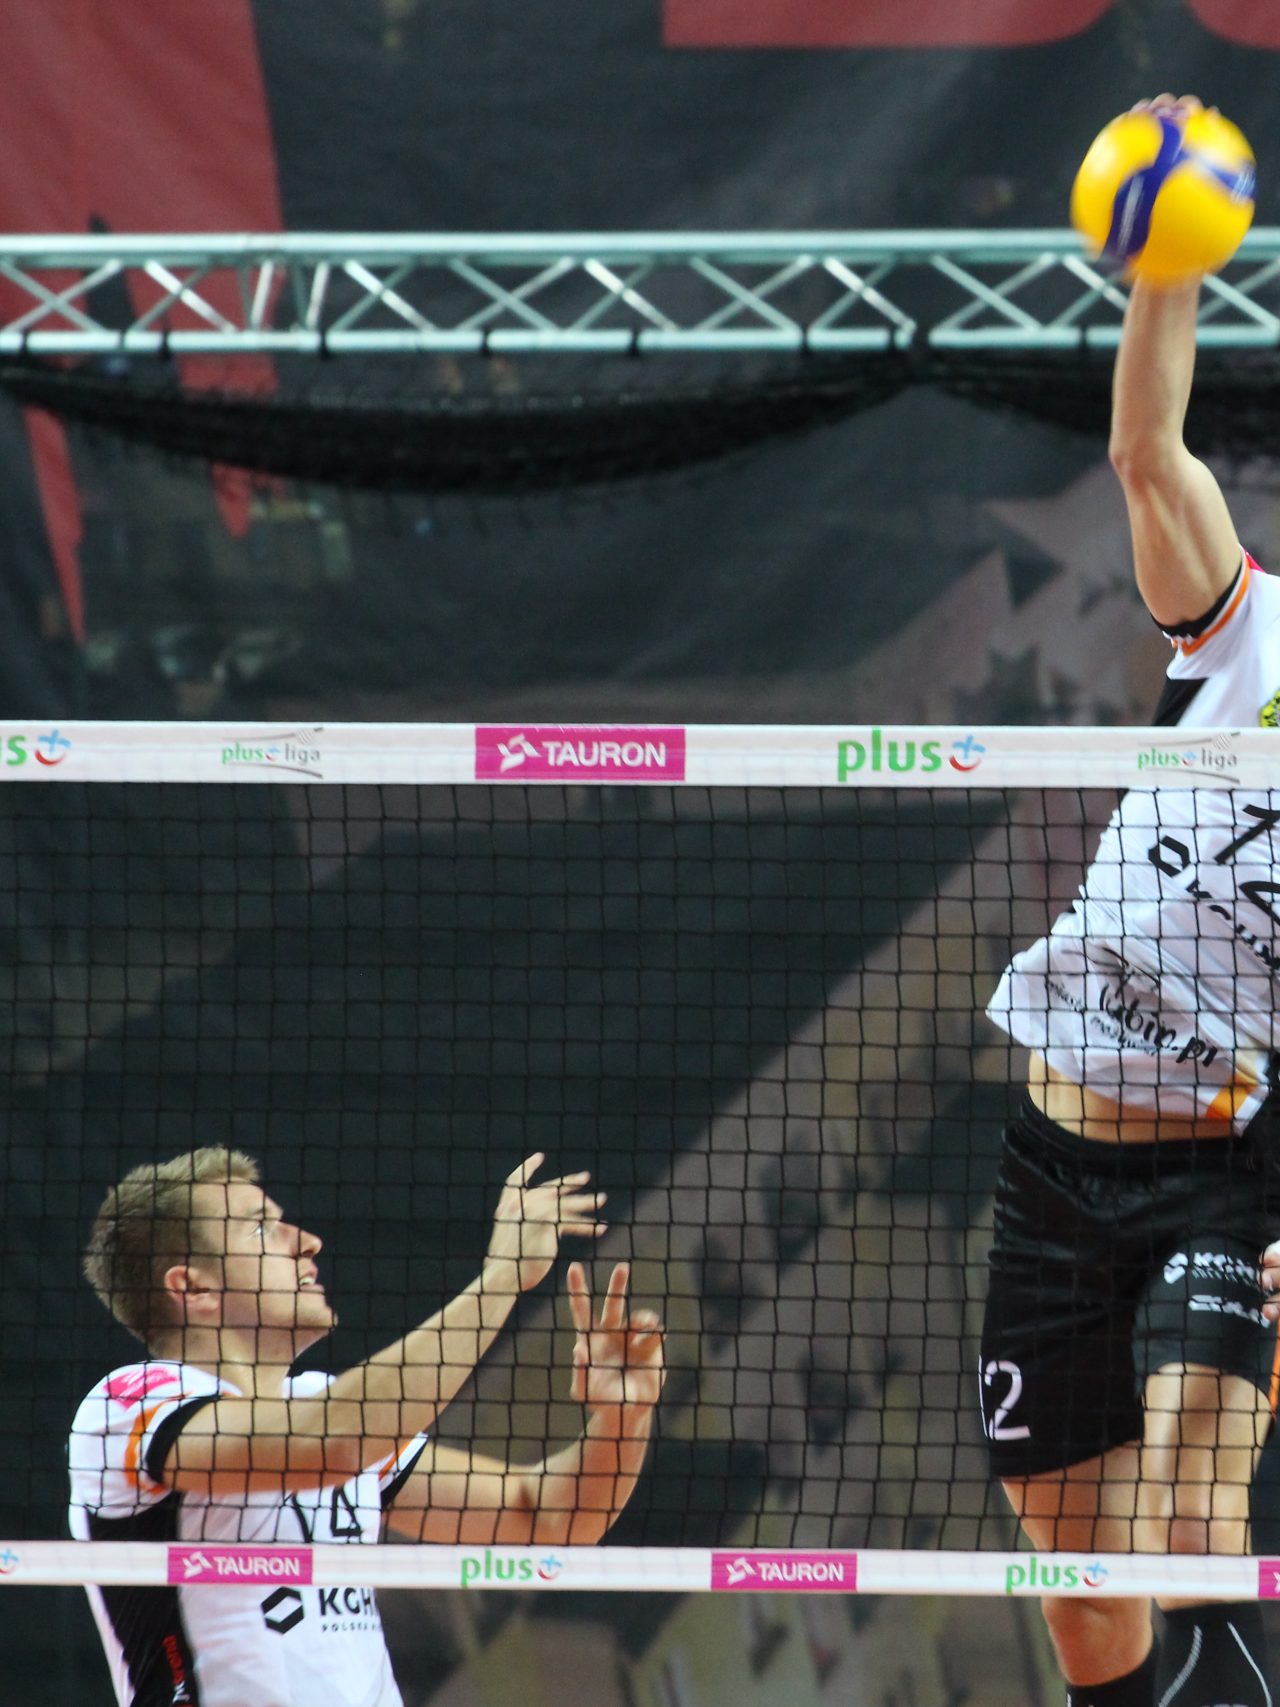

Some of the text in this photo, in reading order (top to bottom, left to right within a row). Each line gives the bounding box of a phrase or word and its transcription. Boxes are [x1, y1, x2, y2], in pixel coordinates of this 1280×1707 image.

[541, 741, 667, 768] TAURON
[836, 726, 943, 783] plus
[214, 1555, 301, 1578] TAURON
[460, 1549, 533, 1587] plus
[757, 1561, 845, 1583] TAURON
[1004, 1556, 1080, 1594] plus
